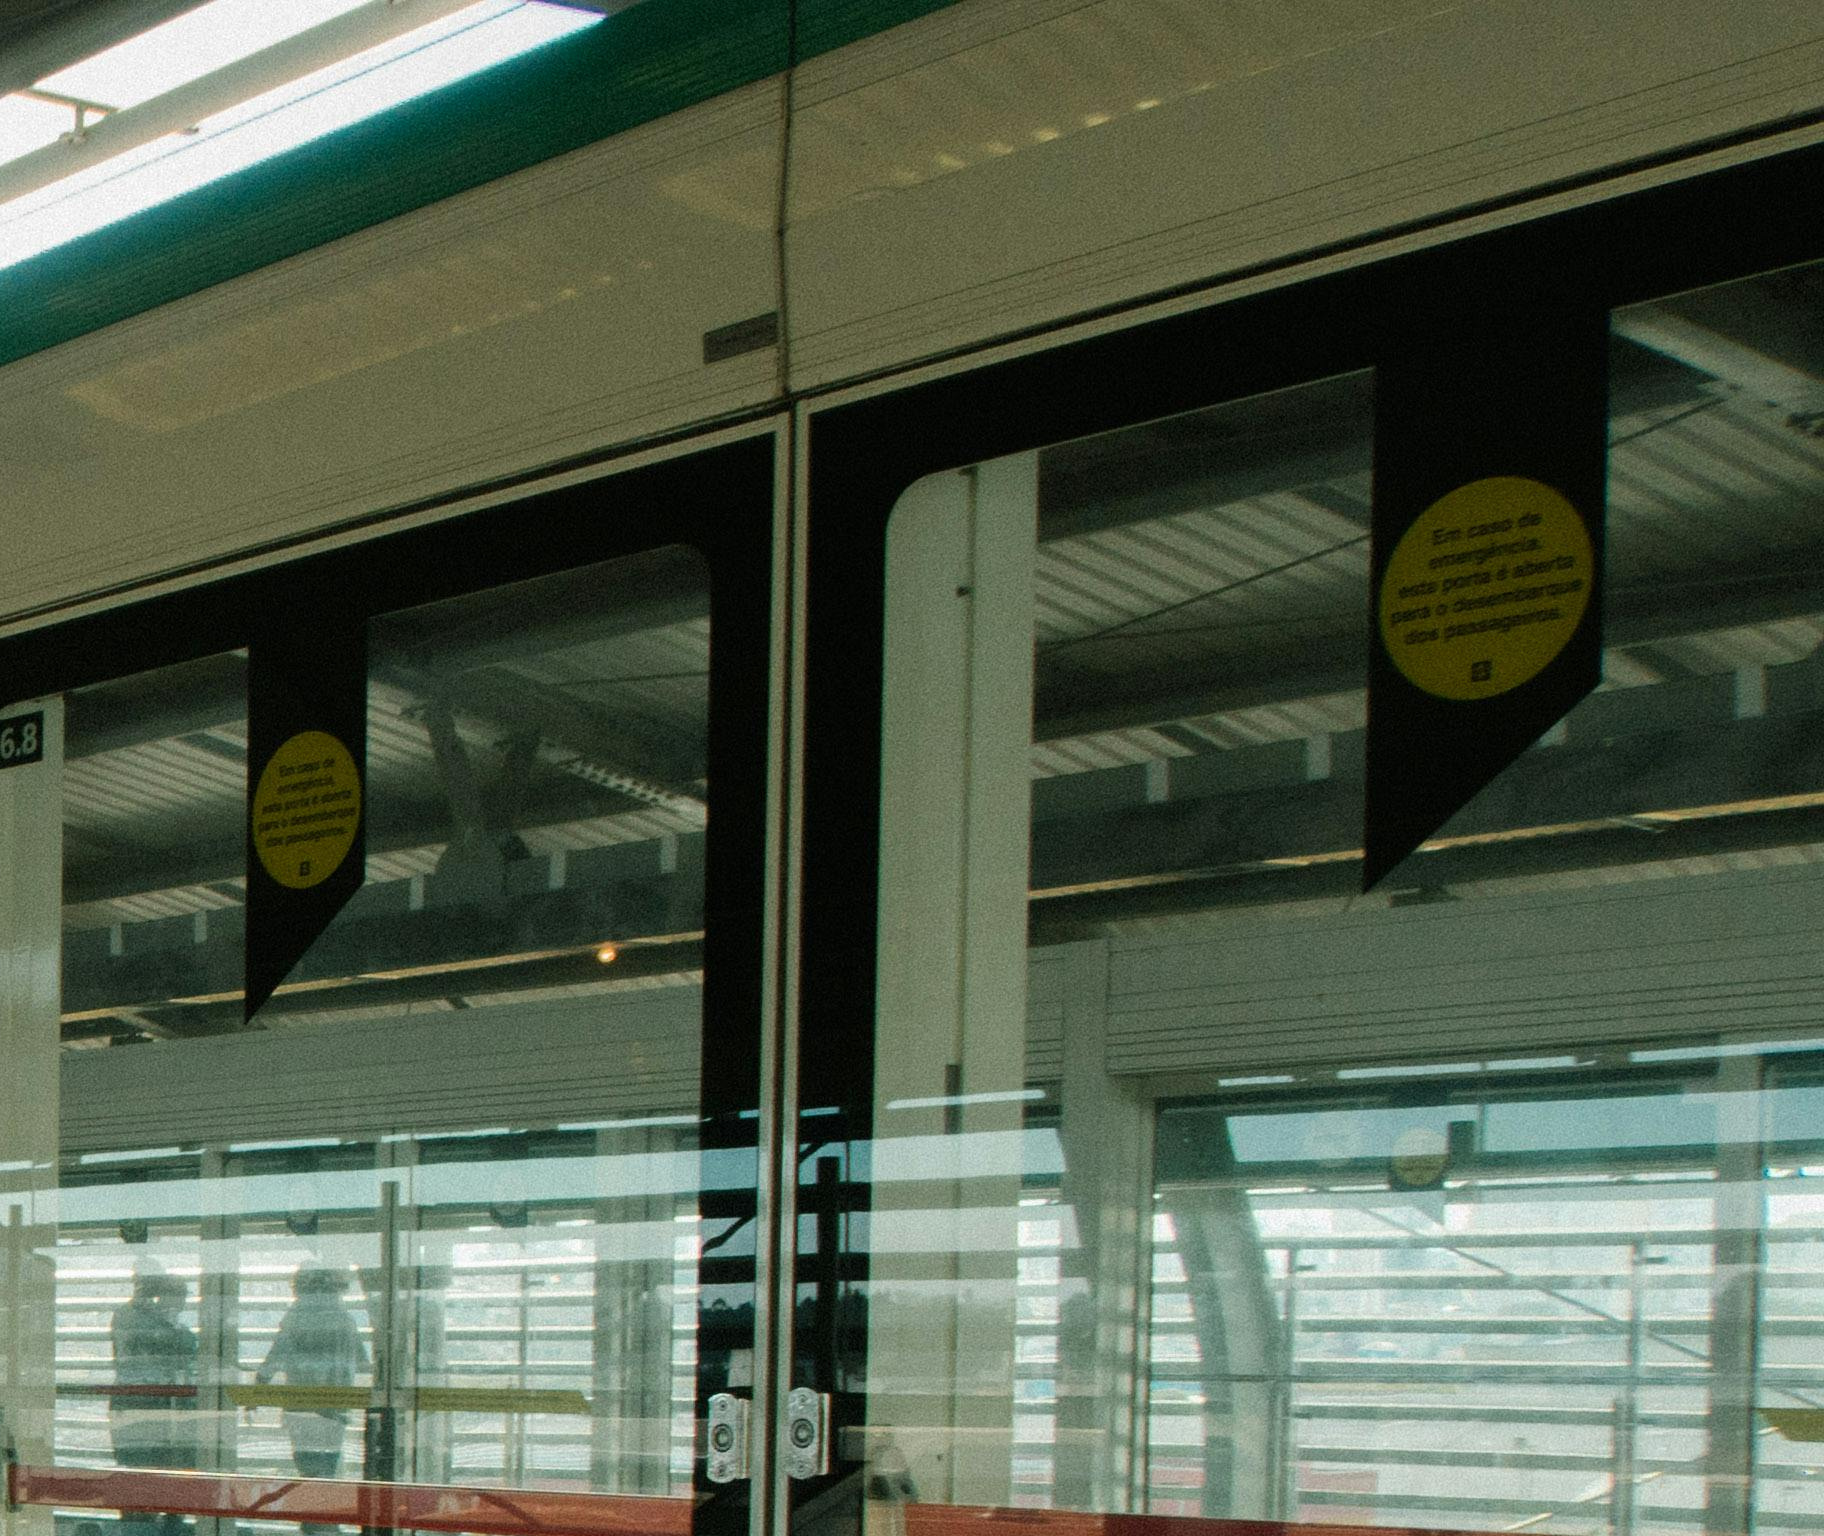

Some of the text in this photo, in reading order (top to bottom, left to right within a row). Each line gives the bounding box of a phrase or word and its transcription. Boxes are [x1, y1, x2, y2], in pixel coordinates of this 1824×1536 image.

[1432, 513, 1542, 545] Em caso de
[1442, 571, 1491, 594] porta
[1436, 604, 1447, 616] o
